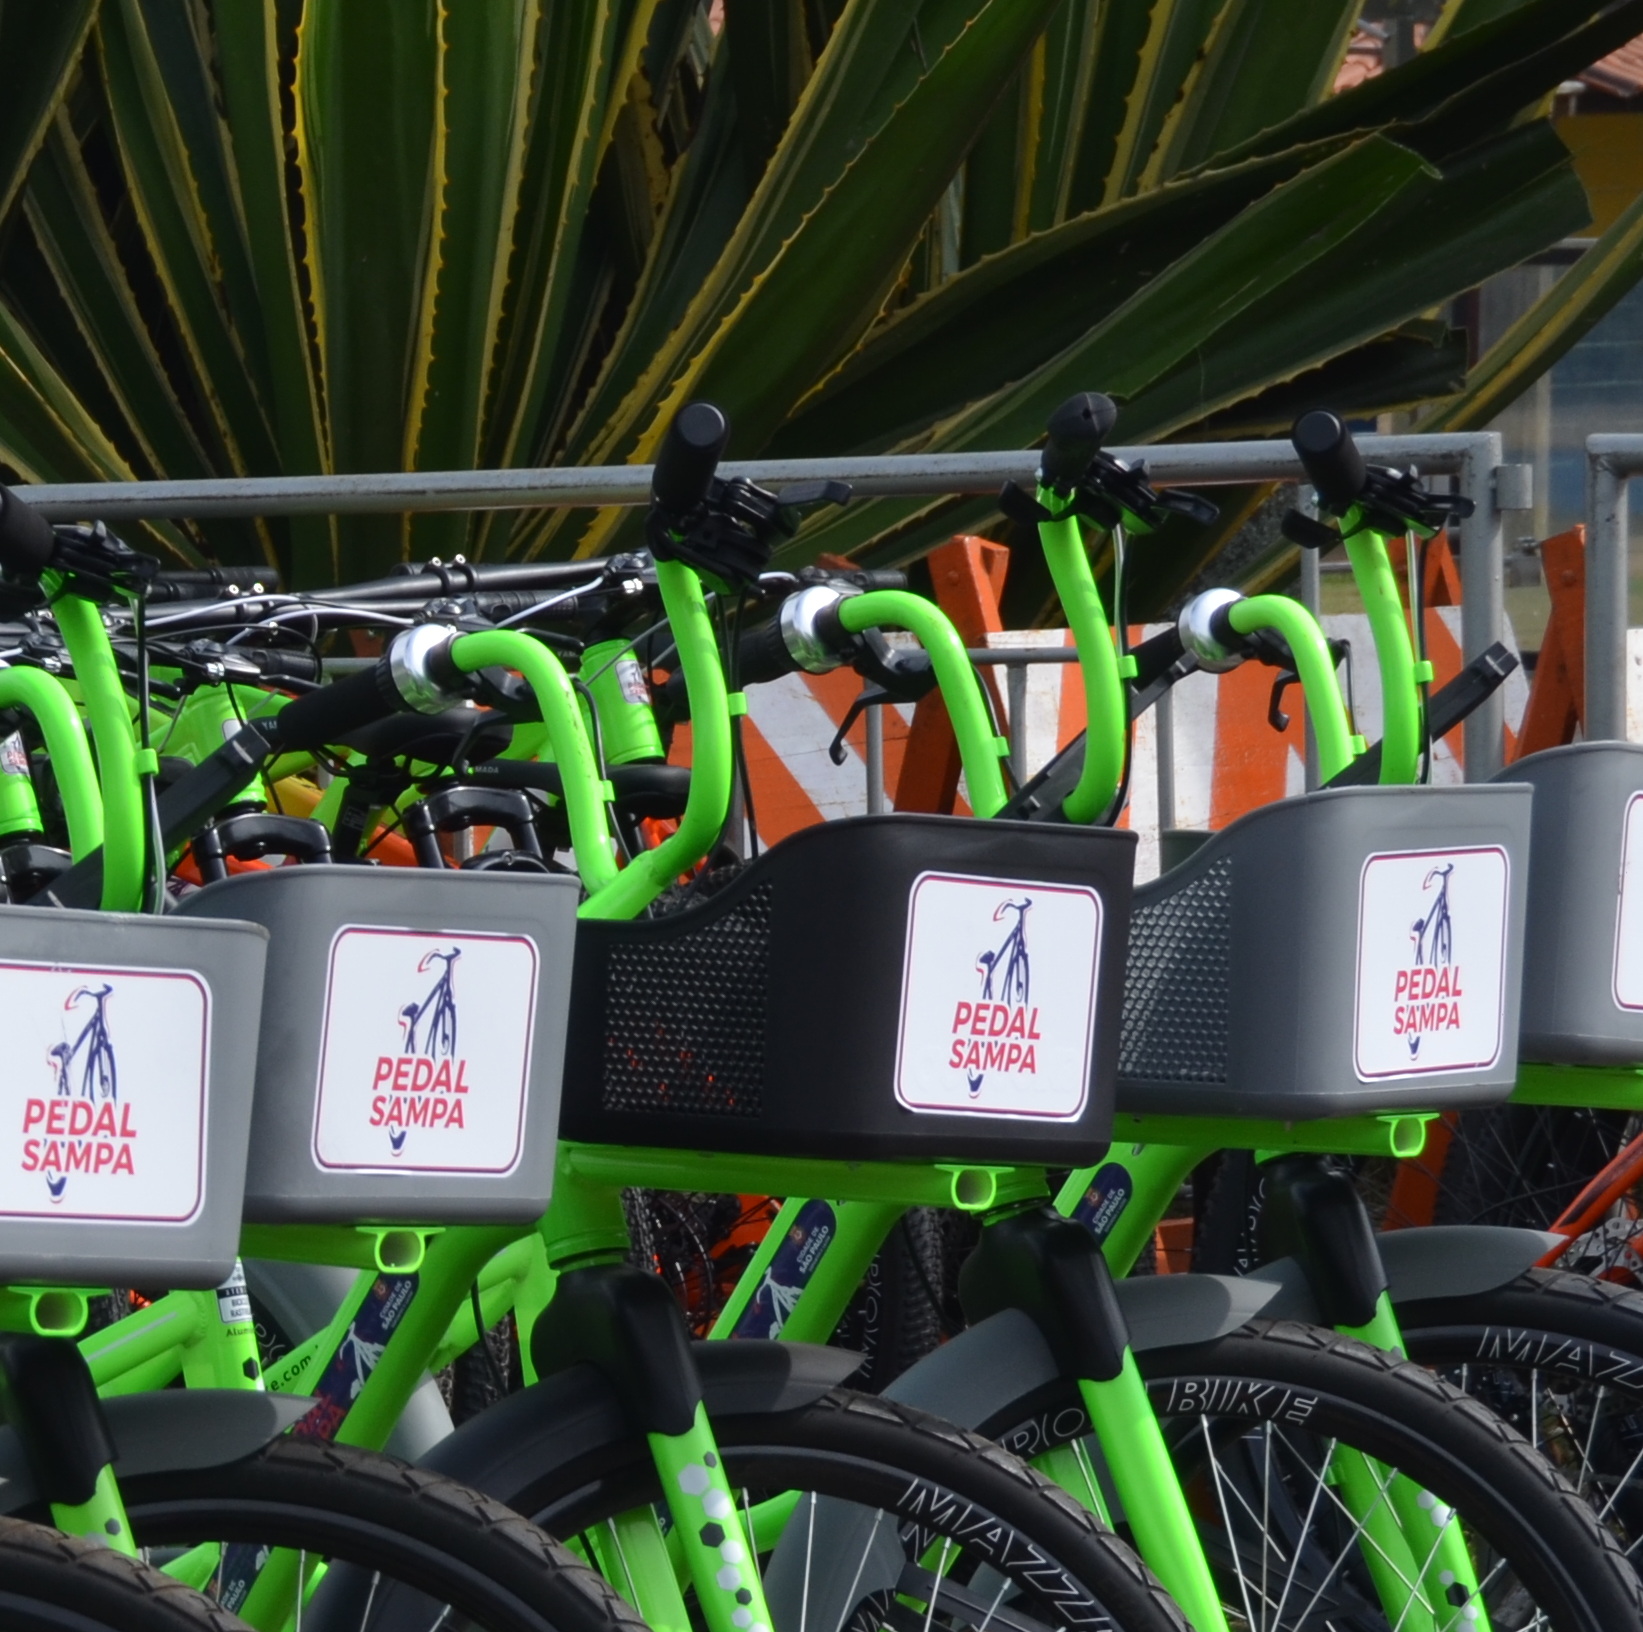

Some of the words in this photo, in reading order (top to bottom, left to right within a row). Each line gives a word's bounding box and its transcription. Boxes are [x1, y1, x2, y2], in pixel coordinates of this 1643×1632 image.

[1395, 967, 1463, 1001] PEDAL
[952, 1001, 1042, 1041] PEDAL
[1393, 1002, 1461, 1035] SAMPA
[949, 1038, 1037, 1074] SAMPA
[373, 1056, 470, 1094] PEDAL
[22, 1098, 138, 1139] PEDAL
[369, 1095, 466, 1130] SAMPA
[21, 1138, 135, 1175] SAMPA
[1105, 1188, 1125, 1216] PAULO
[798, 1254, 813, 1274] SÃO
[810, 1225, 829, 1255] PAULO
[381, 1310, 396, 1331] SÃO
[392, 1280, 412, 1311] PAULO
[1166, 1378, 1319, 1426] BIKE
